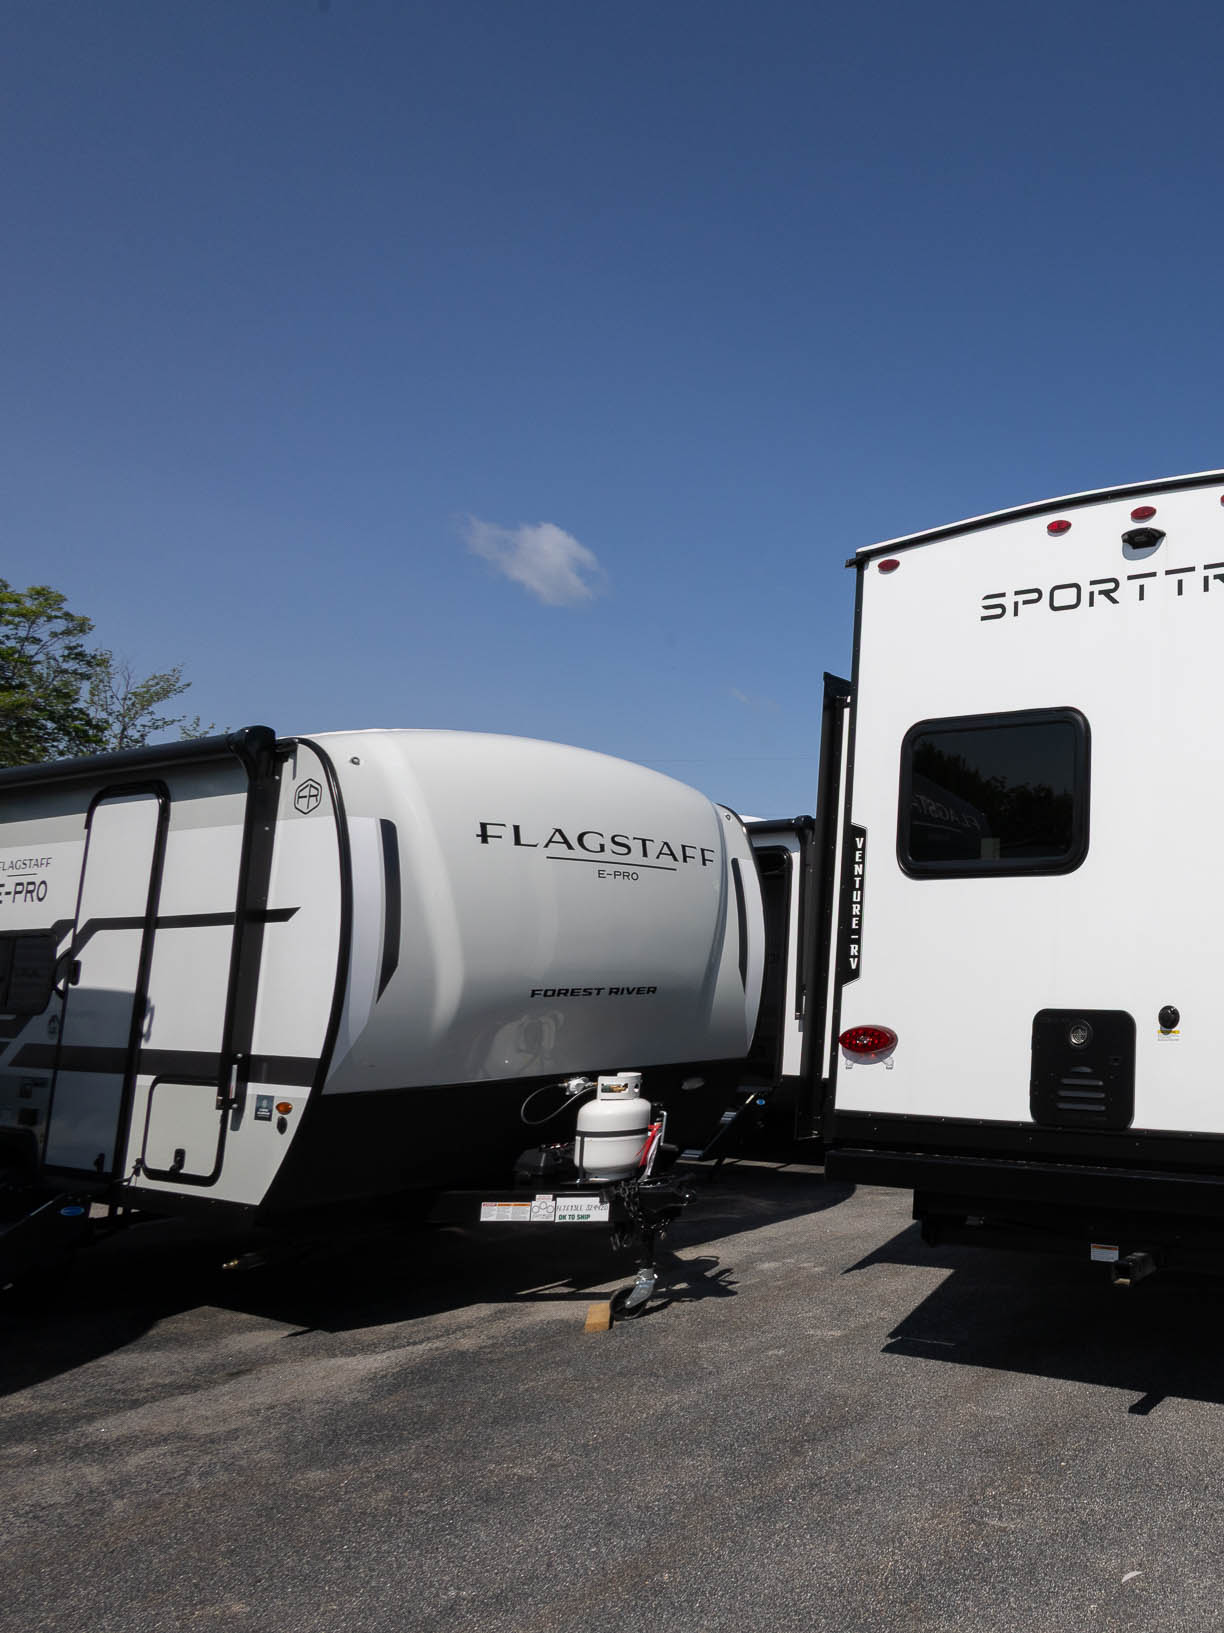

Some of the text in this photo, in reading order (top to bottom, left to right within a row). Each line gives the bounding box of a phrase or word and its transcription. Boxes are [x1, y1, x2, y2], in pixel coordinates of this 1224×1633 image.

[476, 822, 715, 867] FLAGSTAFF
[597, 869, 640, 881] E-PRO
[530, 986, 658, 999] FOREST RIVER
